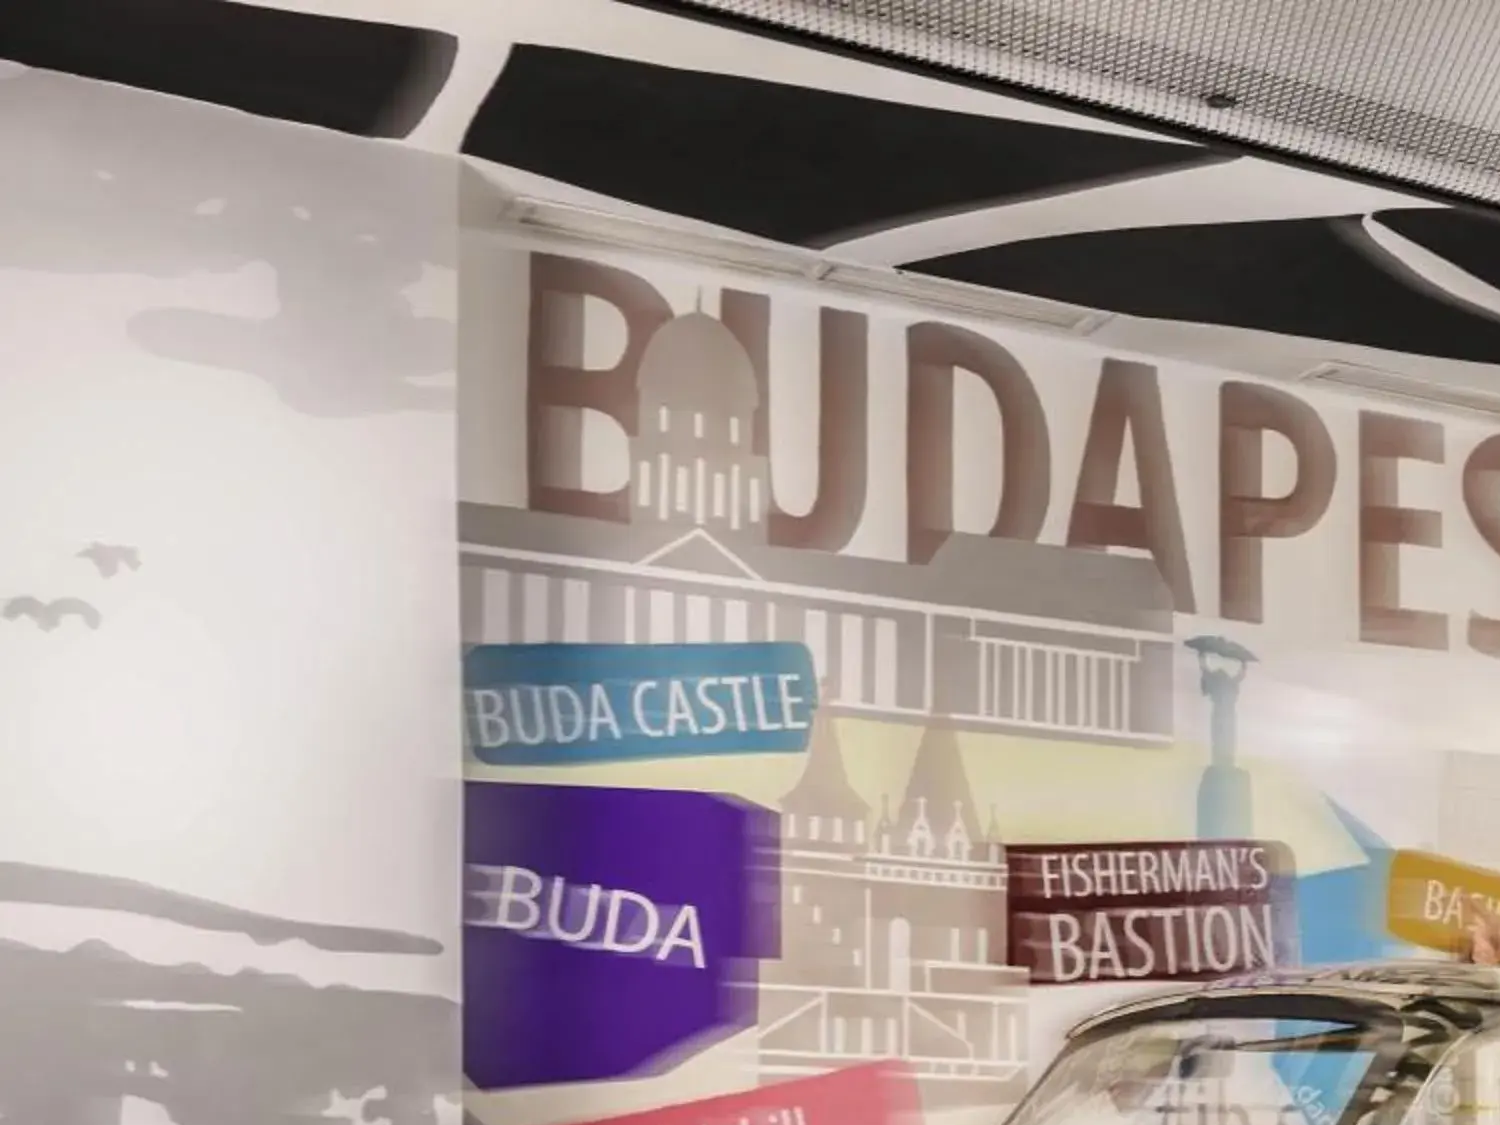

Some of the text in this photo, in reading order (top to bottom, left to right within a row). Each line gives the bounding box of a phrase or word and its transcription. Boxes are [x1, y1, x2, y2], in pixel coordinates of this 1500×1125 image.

[475, 673, 809, 748] BUDA CASTLE
[1041, 846, 1269, 899] FISHERMAN'S
[496, 864, 706, 969] BUDA
[1049, 904, 1276, 983] BASTION
